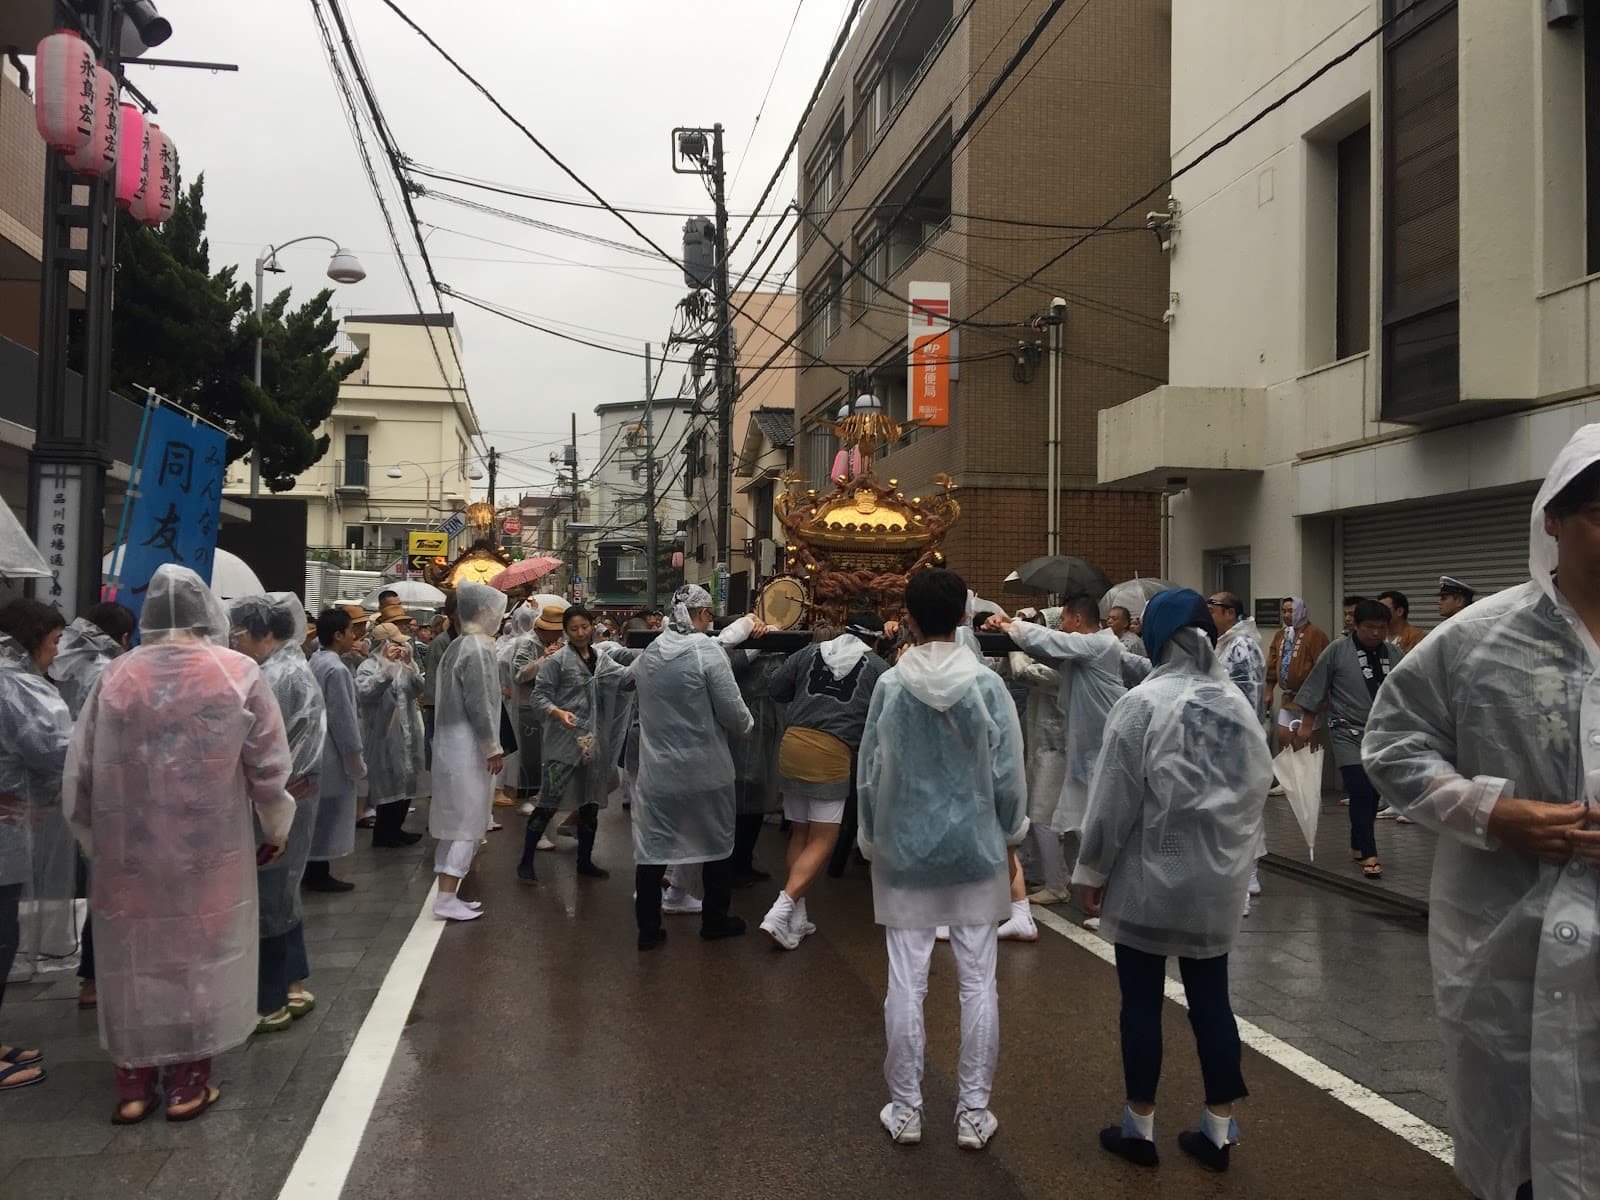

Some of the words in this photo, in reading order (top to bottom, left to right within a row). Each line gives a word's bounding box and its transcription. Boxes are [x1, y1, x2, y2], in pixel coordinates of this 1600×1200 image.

[924, 359, 936, 398] 郵便局
[131, 440, 194, 595] 同友
